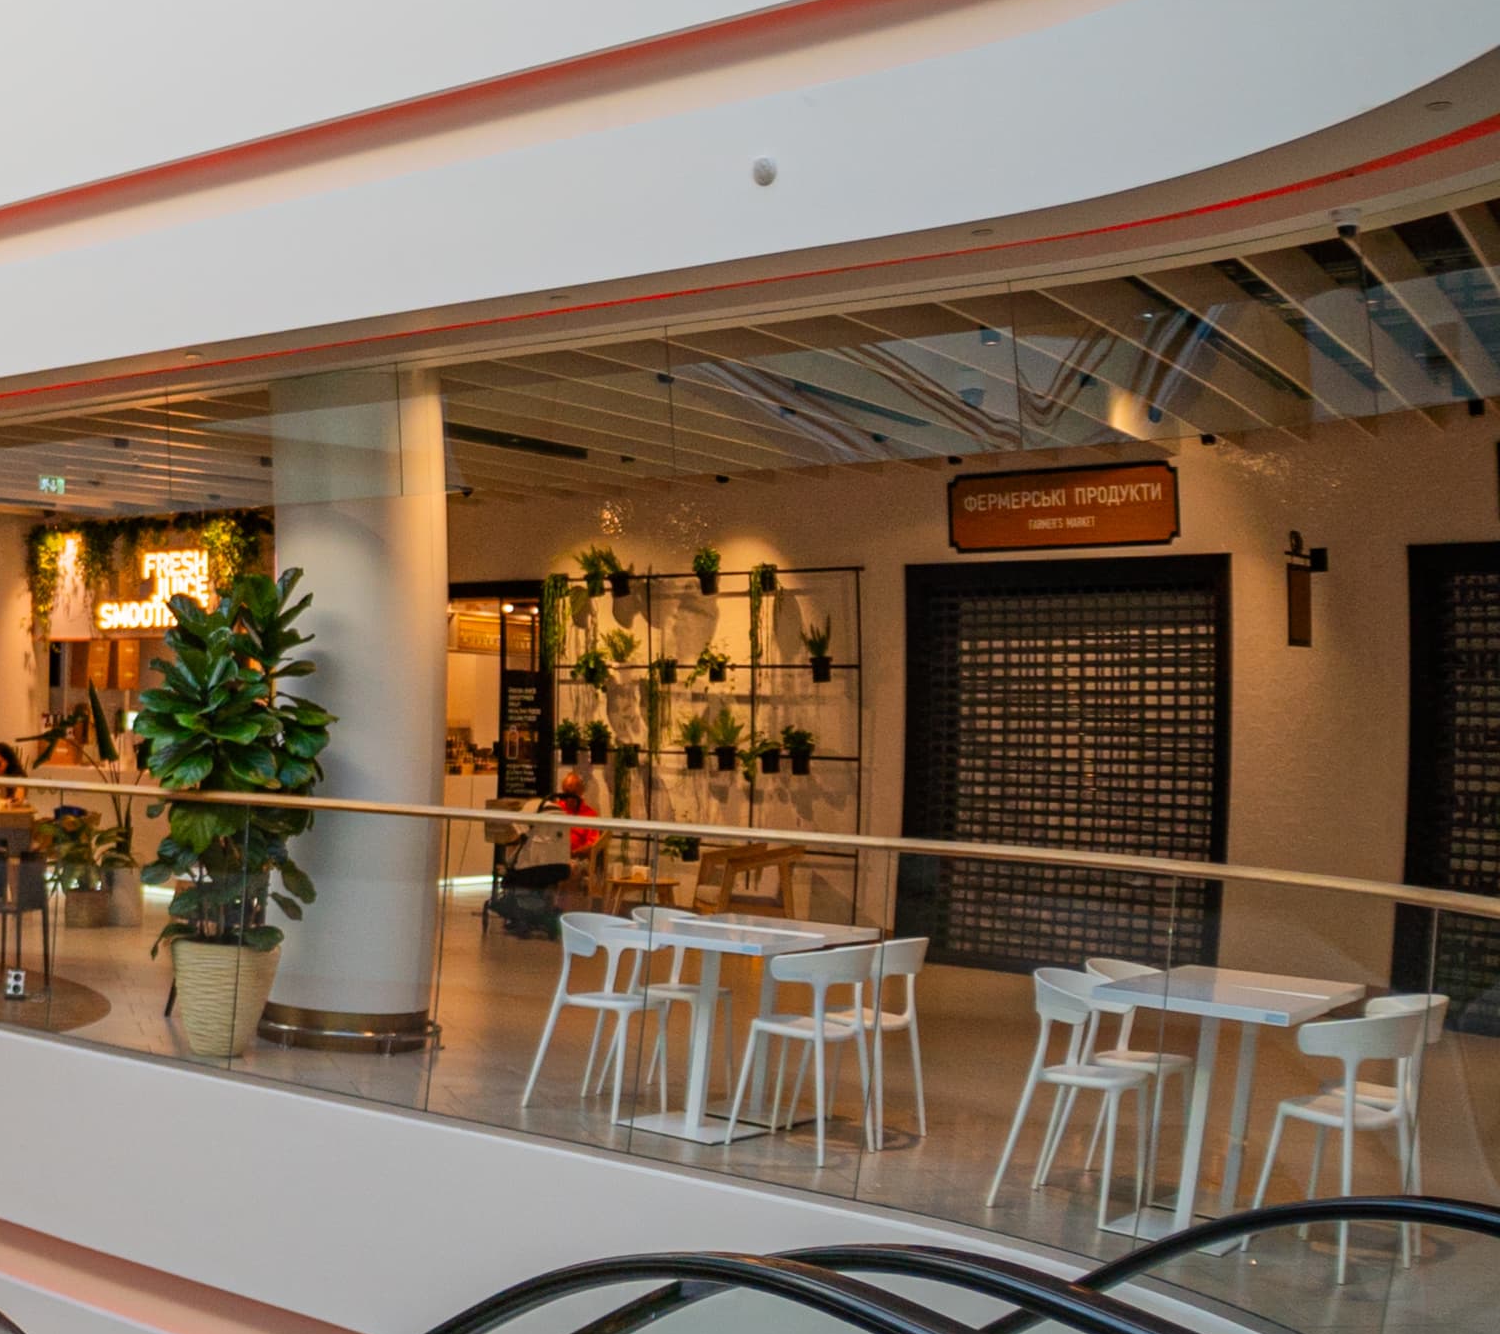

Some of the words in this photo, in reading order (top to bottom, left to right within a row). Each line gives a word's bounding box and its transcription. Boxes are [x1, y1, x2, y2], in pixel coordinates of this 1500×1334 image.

[964, 489, 1066, 512] ФЕРМЕРСЬКІ
[1075, 482, 1163, 506] ПРОДУКТИ
[143, 550, 209, 580] FRESH
